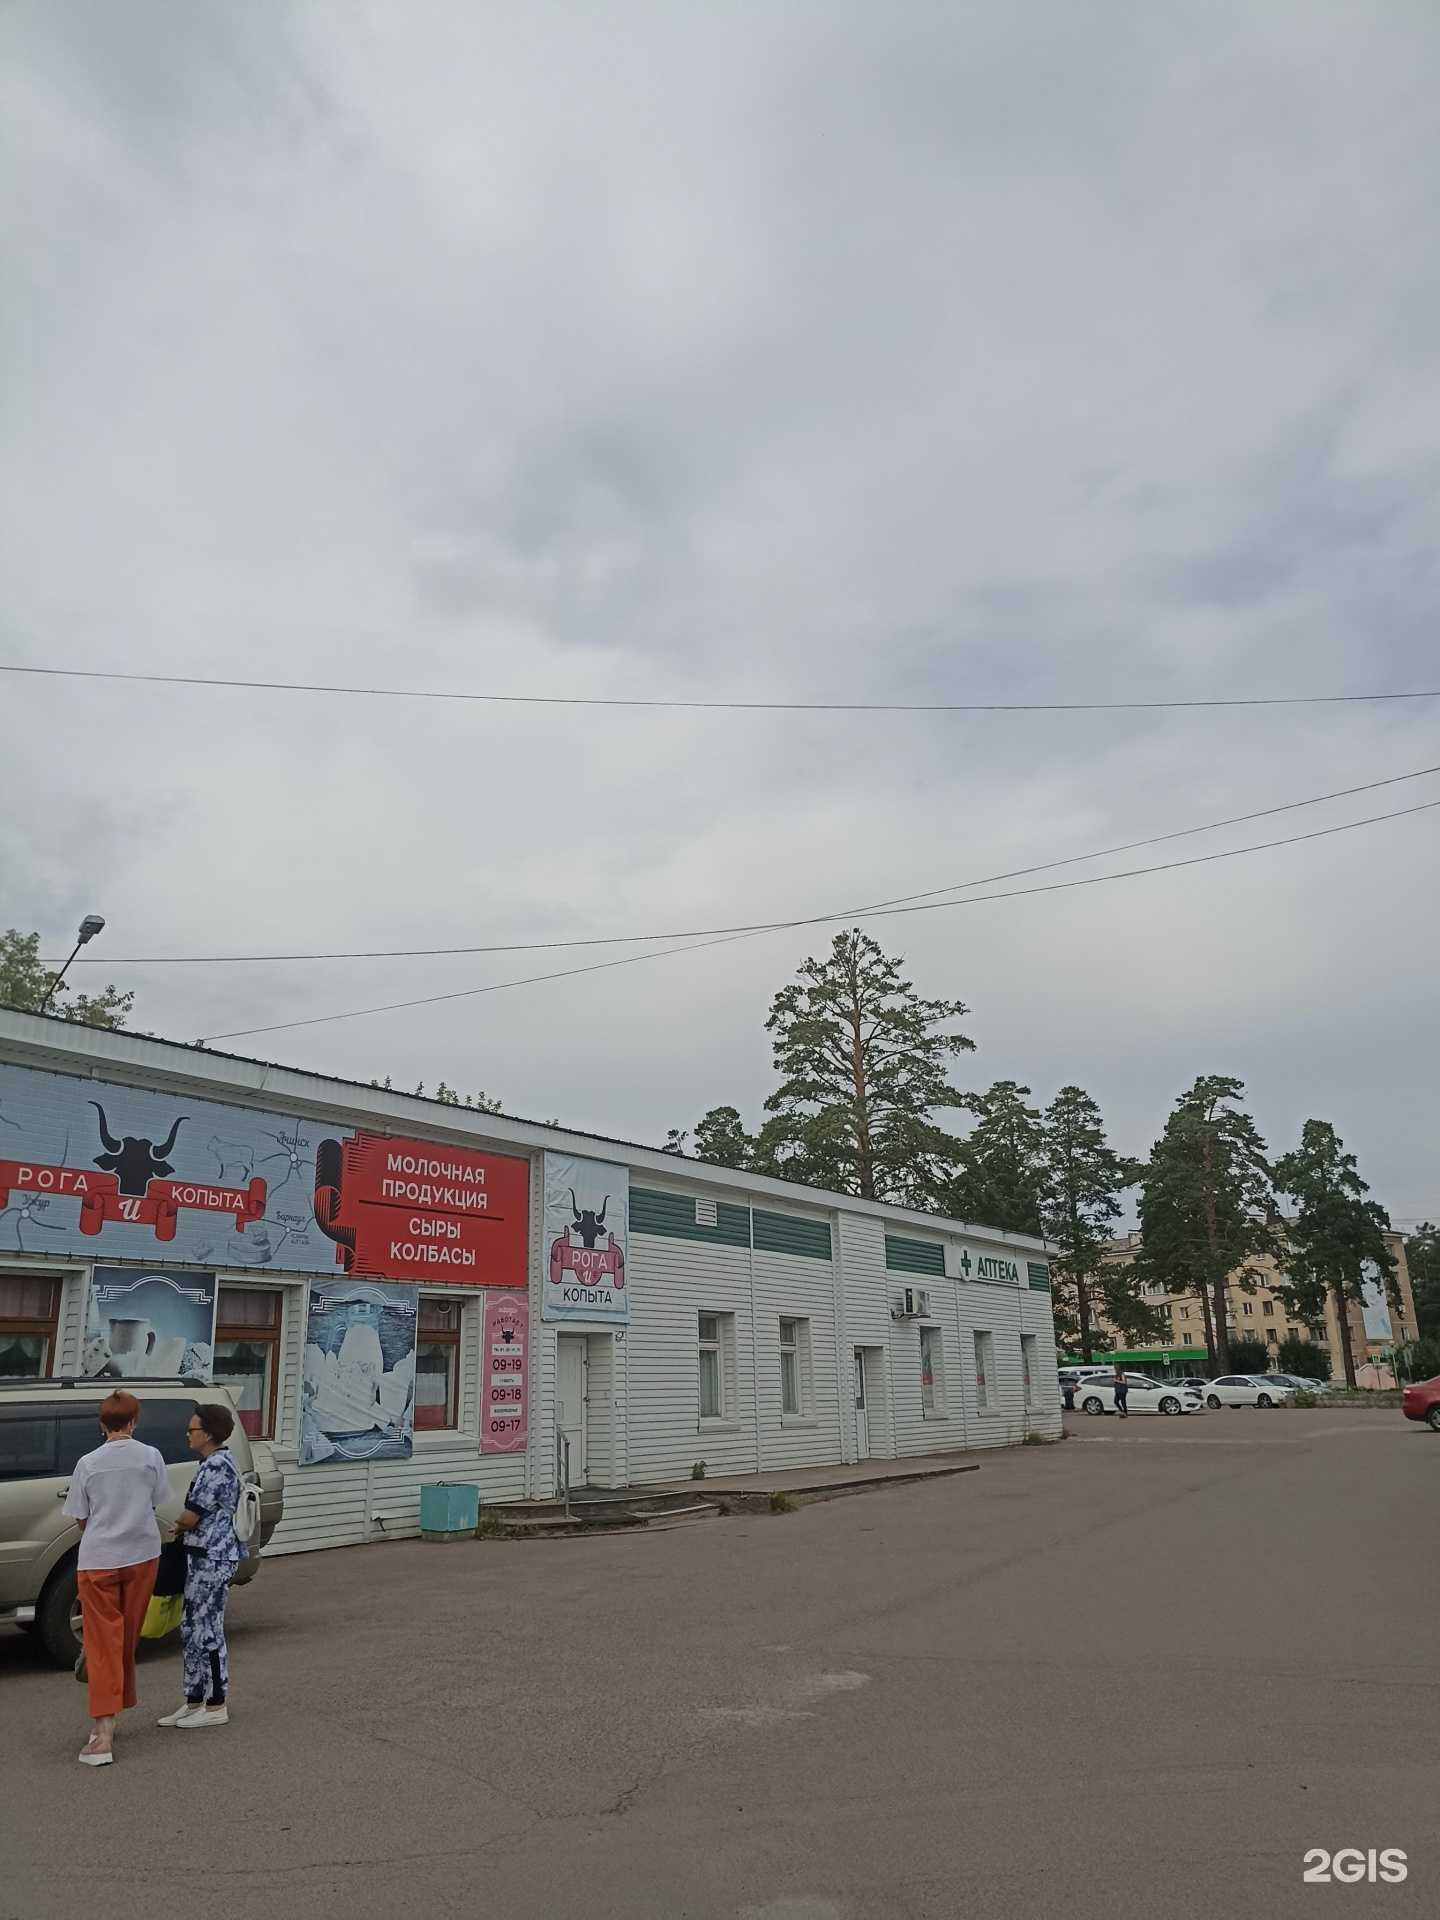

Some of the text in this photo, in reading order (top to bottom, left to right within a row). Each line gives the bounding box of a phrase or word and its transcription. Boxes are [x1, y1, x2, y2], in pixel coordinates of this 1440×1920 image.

[17, 1167, 88, 1192] РОГА
[387, 1153, 485, 1185] МОЛОЧНАЯ
[171, 1186, 244, 1209] КОПЫТА
[382, 1179, 488, 1210] ПРОДУКЦИЯ
[409, 1217, 461, 1239] СЫРЫ
[390, 1241, 476, 1266] КОЛБАСЫ
[571, 1250, 608, 1270] РОГА
[977, 1257, 1019, 1282] АПТЕКА
[563, 1287, 613, 1304] КОПЫТА
[492, 1359, 522, 1371] 09-19
[491, 1388, 521, 1401] 09-18
[490, 1419, 520, 1433] 09-17
